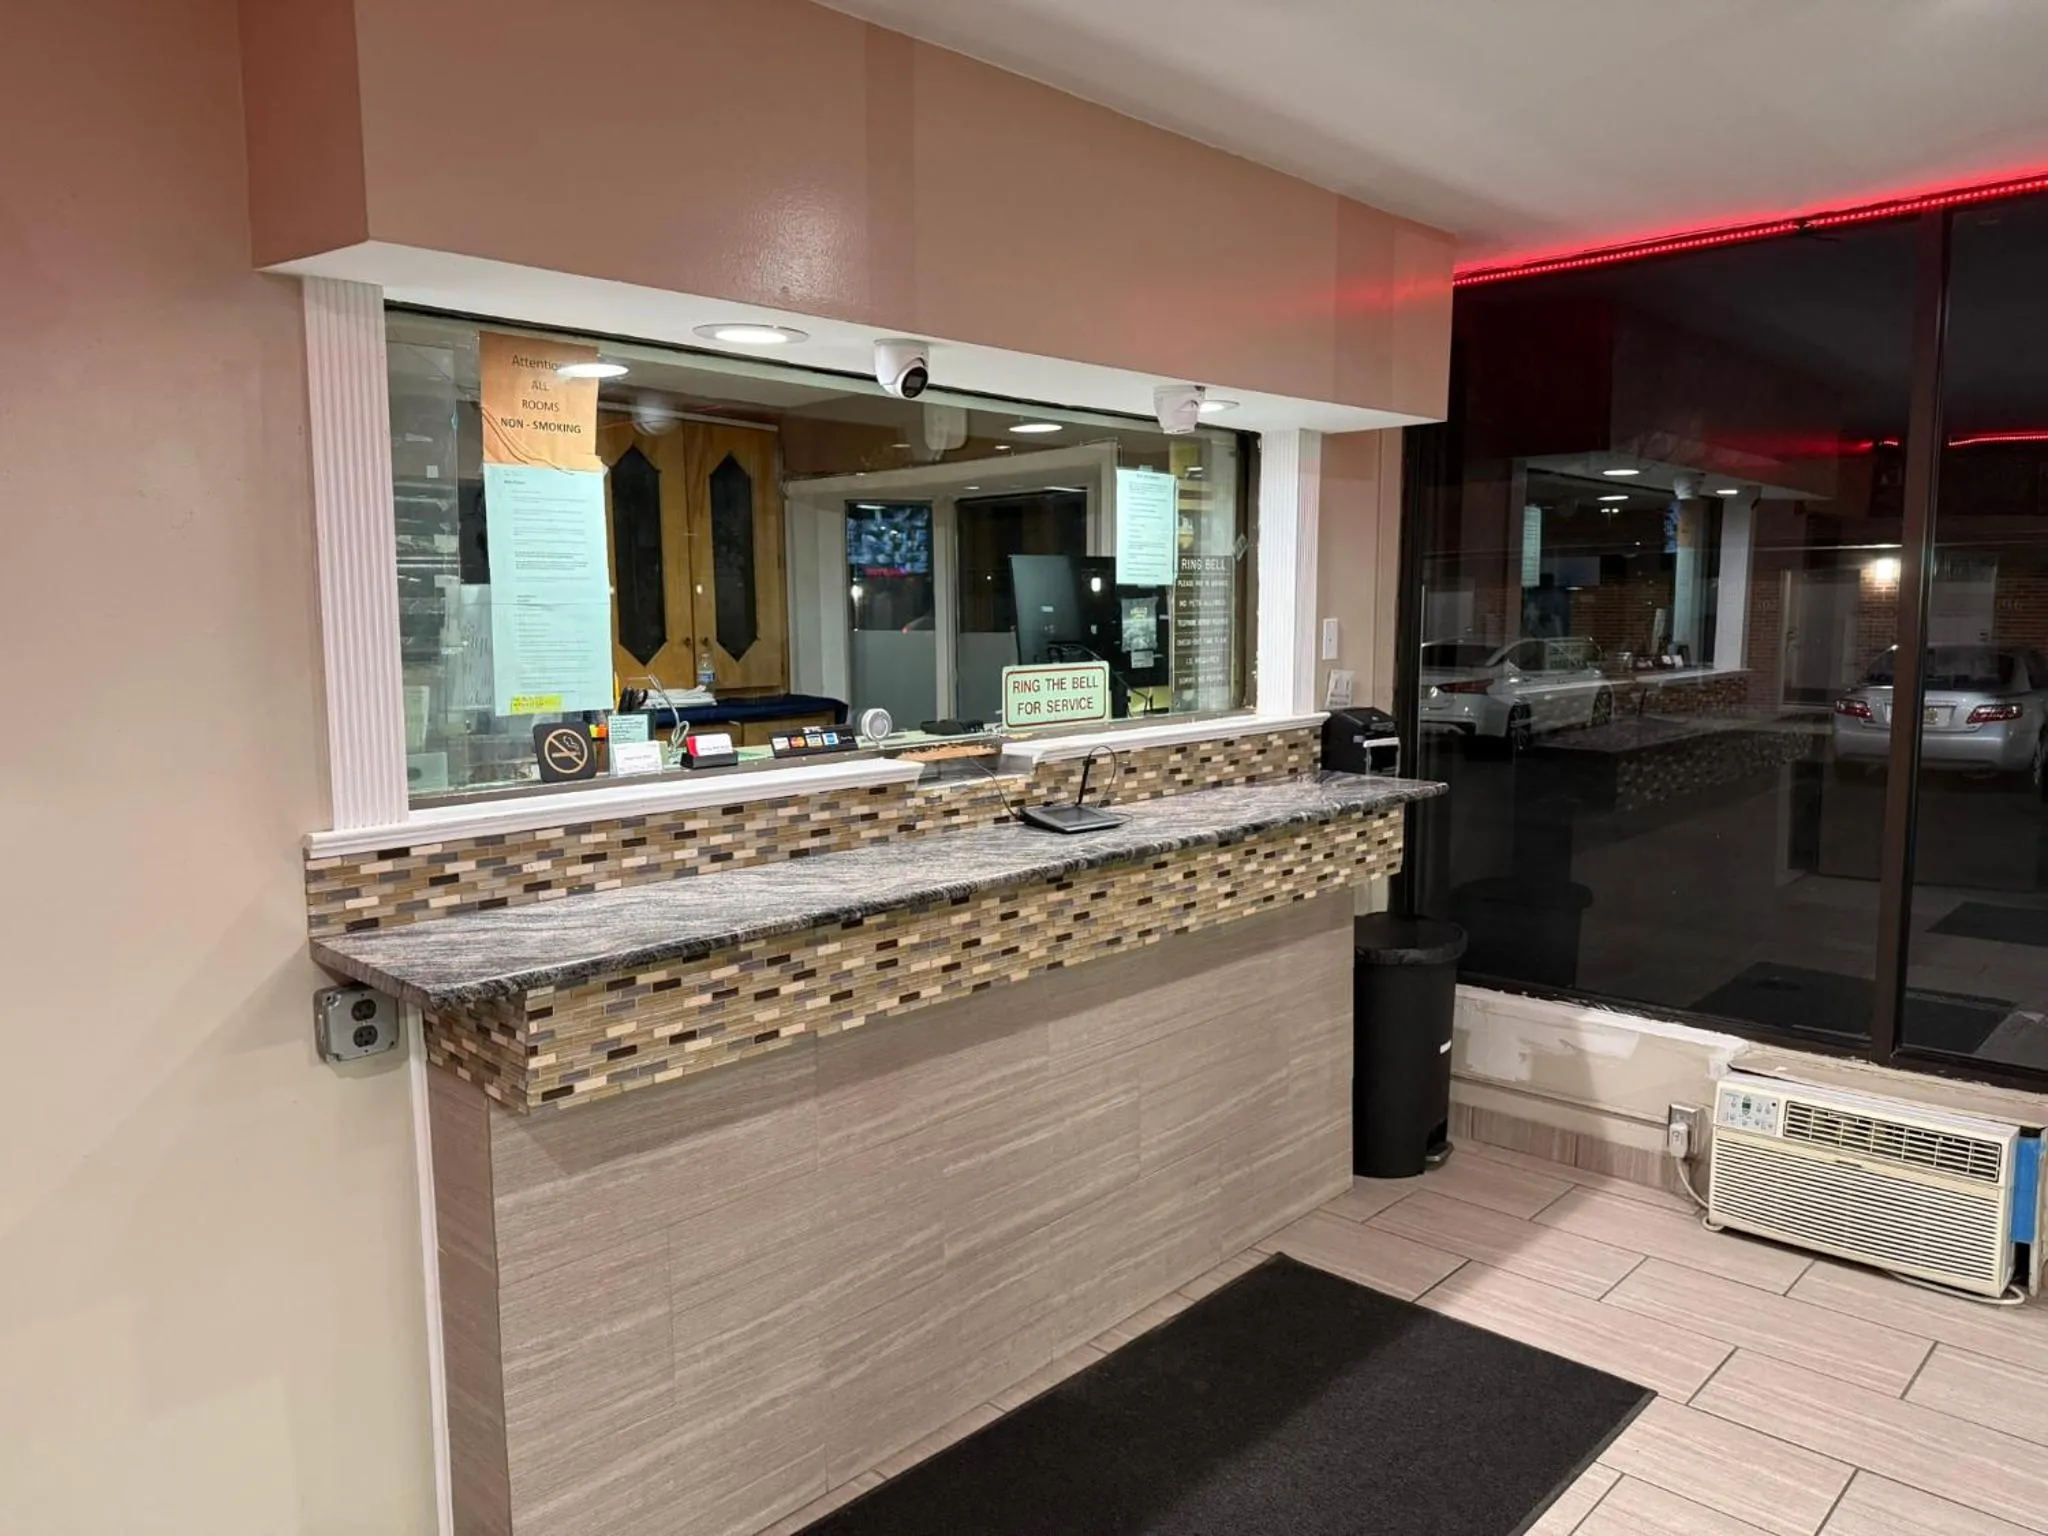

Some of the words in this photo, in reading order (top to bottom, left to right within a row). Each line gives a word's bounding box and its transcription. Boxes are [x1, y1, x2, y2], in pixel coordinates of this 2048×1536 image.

[511, 354, 561, 371] Attentio
[531, 380, 550, 392] ALL
[521, 399, 560, 413] ROOMS
[500, 417, 524, 429] NON
[532, 420, 582, 434] SMOKING
[1205, 558, 1225, 570] BELL
[1012, 679, 1041, 694] RING
[1045, 677, 1067, 691] THE
[1072, 675, 1099, 689] BELL
[1017, 701, 1041, 716] FOR
[1046, 696, 1094, 713] SERVICE
